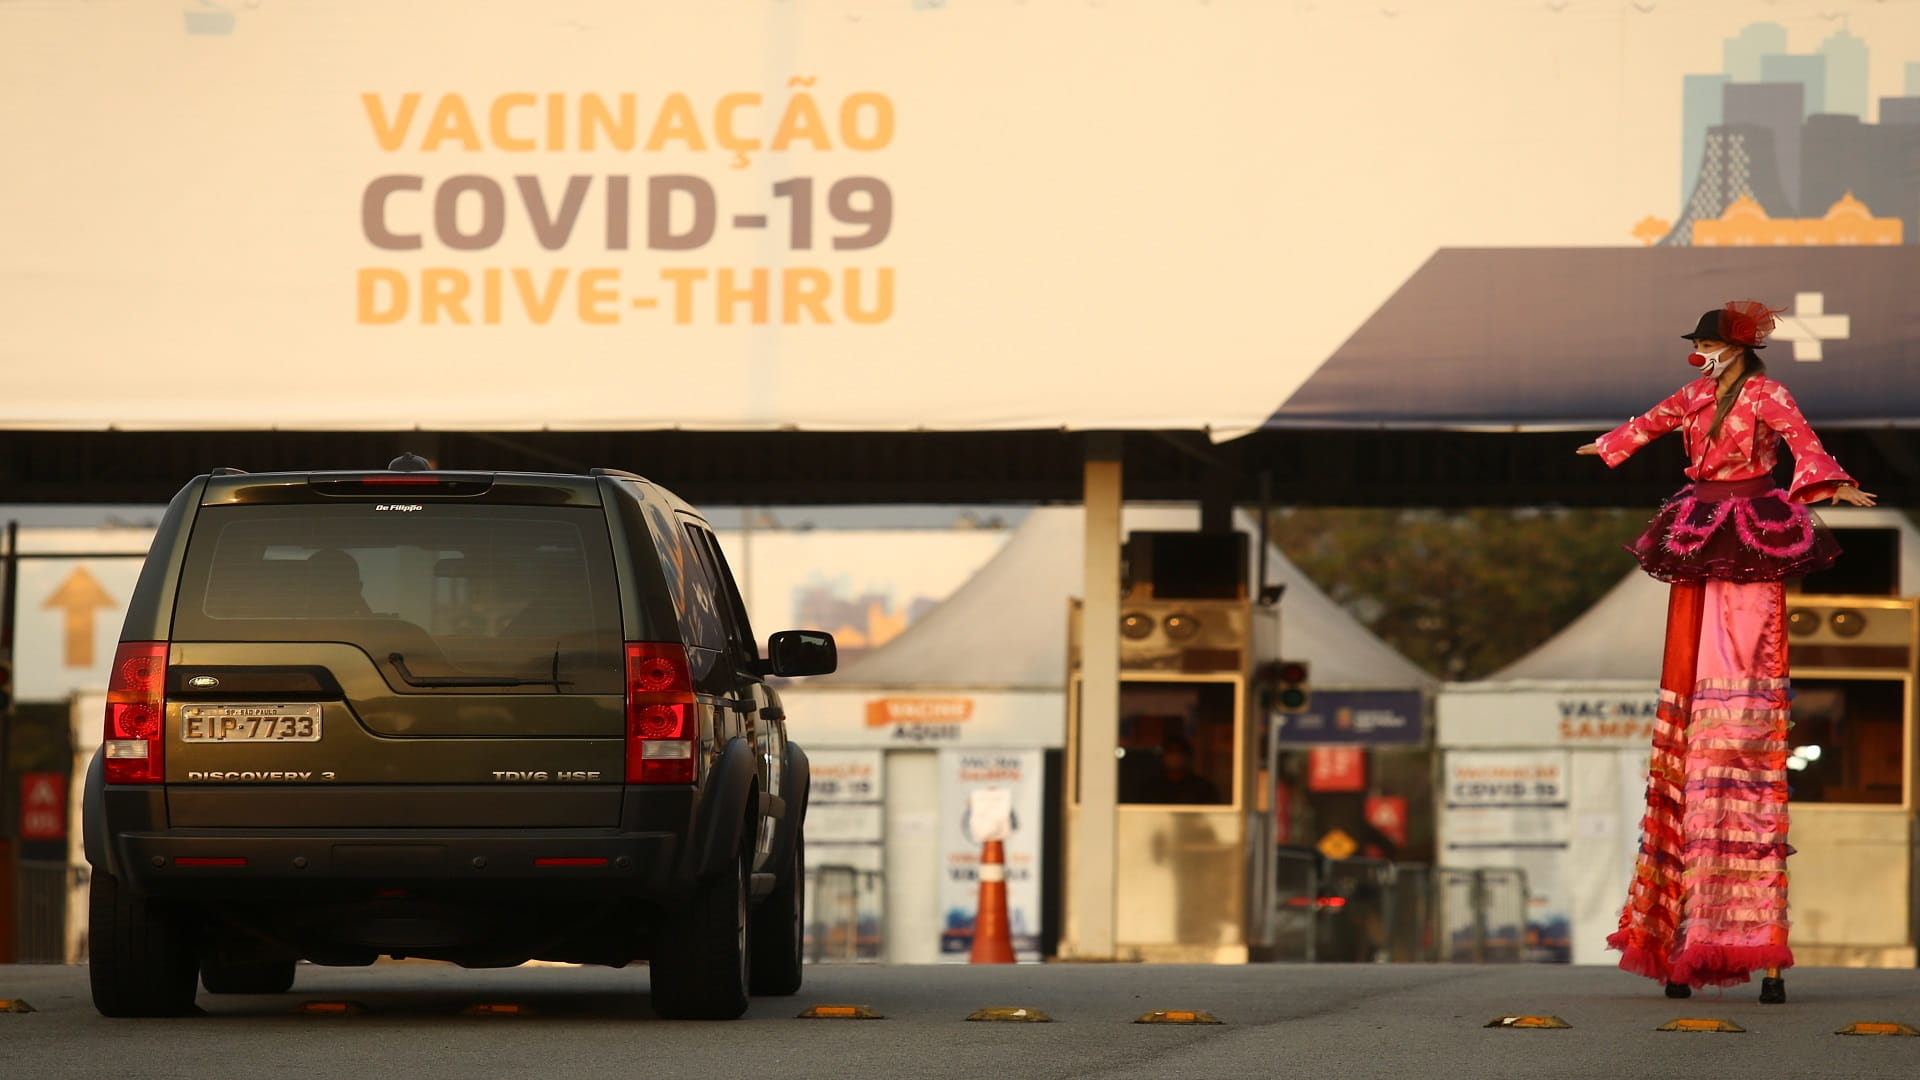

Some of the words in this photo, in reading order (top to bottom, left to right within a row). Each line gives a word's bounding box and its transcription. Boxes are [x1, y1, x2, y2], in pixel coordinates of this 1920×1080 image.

[360, 76, 897, 170] VACINAÇÃO
[360, 173, 894, 252] COVID-19
[355, 266, 896, 327] DRIVE-THRU
[390, 504, 423, 513] Filippo
[187, 771, 313, 783] DISCOVERY
[320, 771, 336, 783] 3
[492, 770, 549, 782] TDV6
[556, 770, 602, 782] HSE
